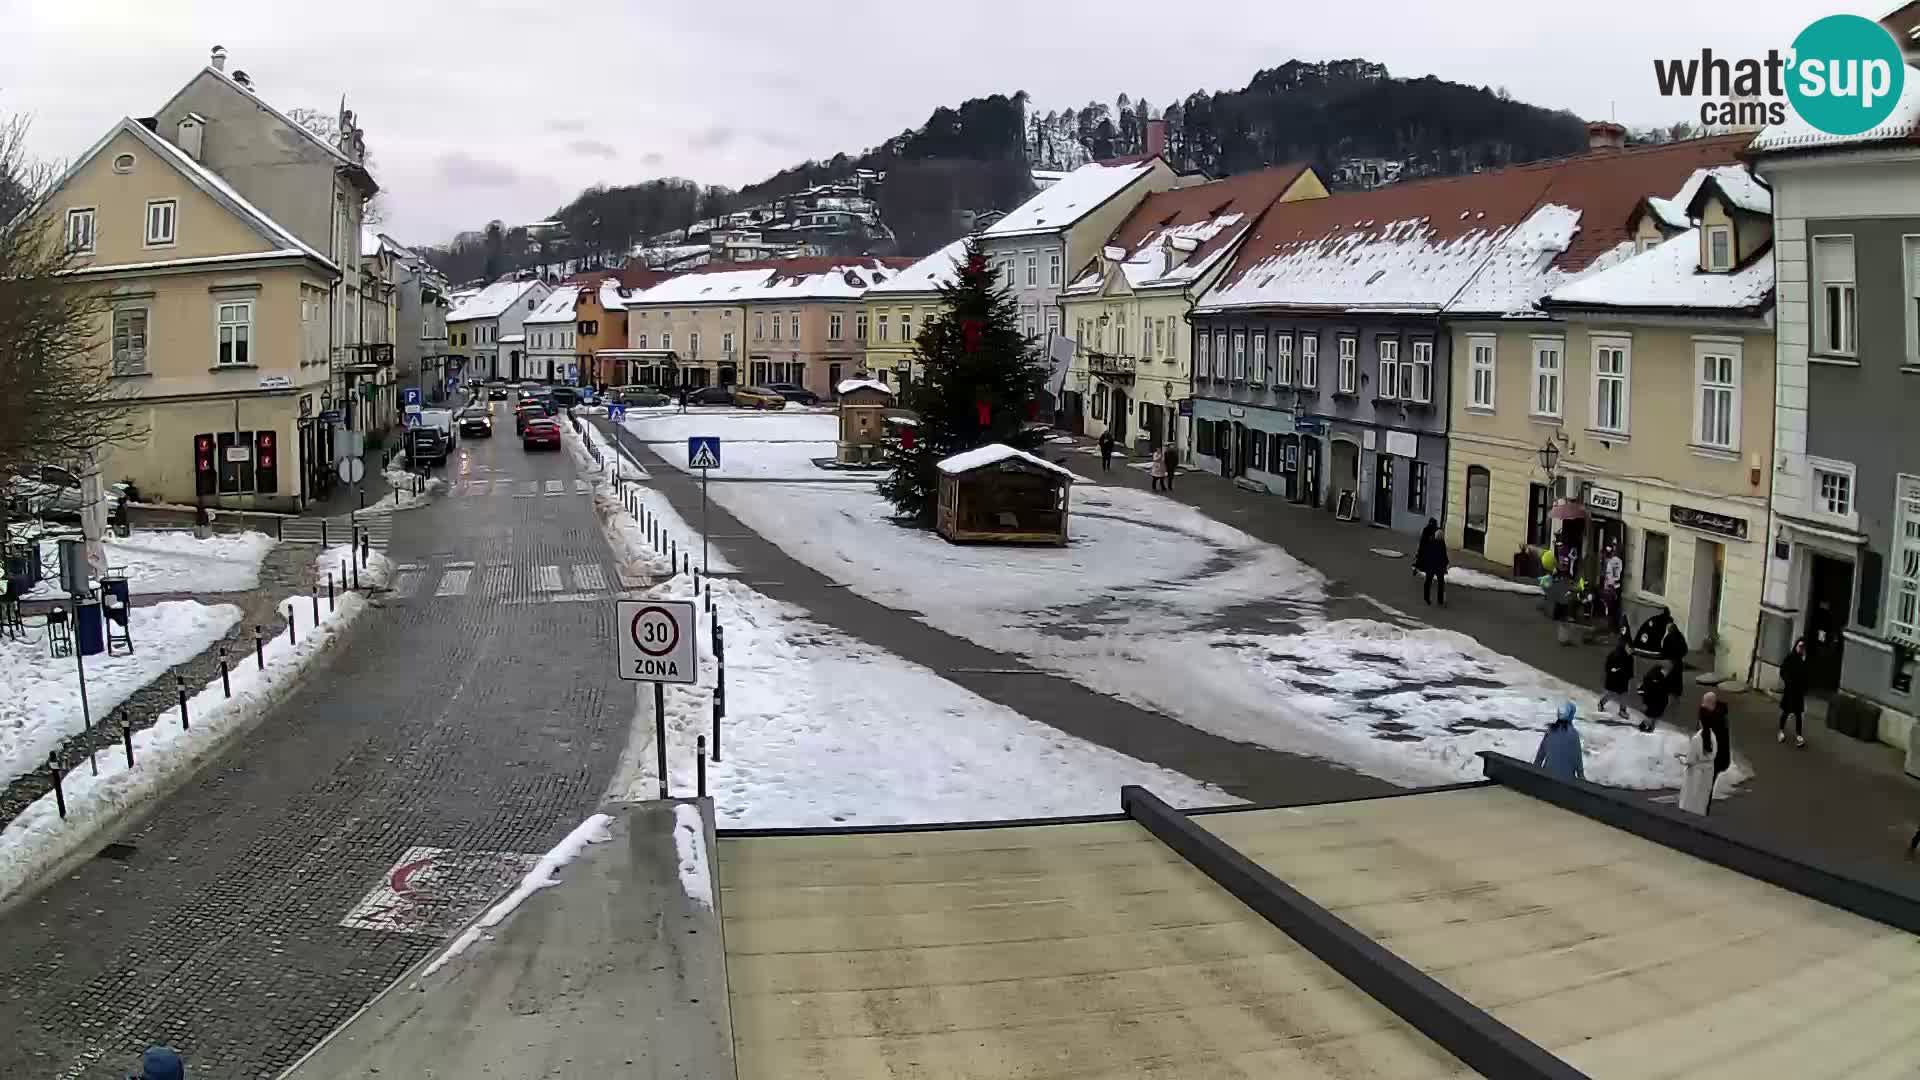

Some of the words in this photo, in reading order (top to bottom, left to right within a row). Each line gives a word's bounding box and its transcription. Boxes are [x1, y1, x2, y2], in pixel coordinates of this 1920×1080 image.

[408, 391, 416, 402] P
[644, 622, 668, 642] 30
[634, 659, 678, 676] ZONA
